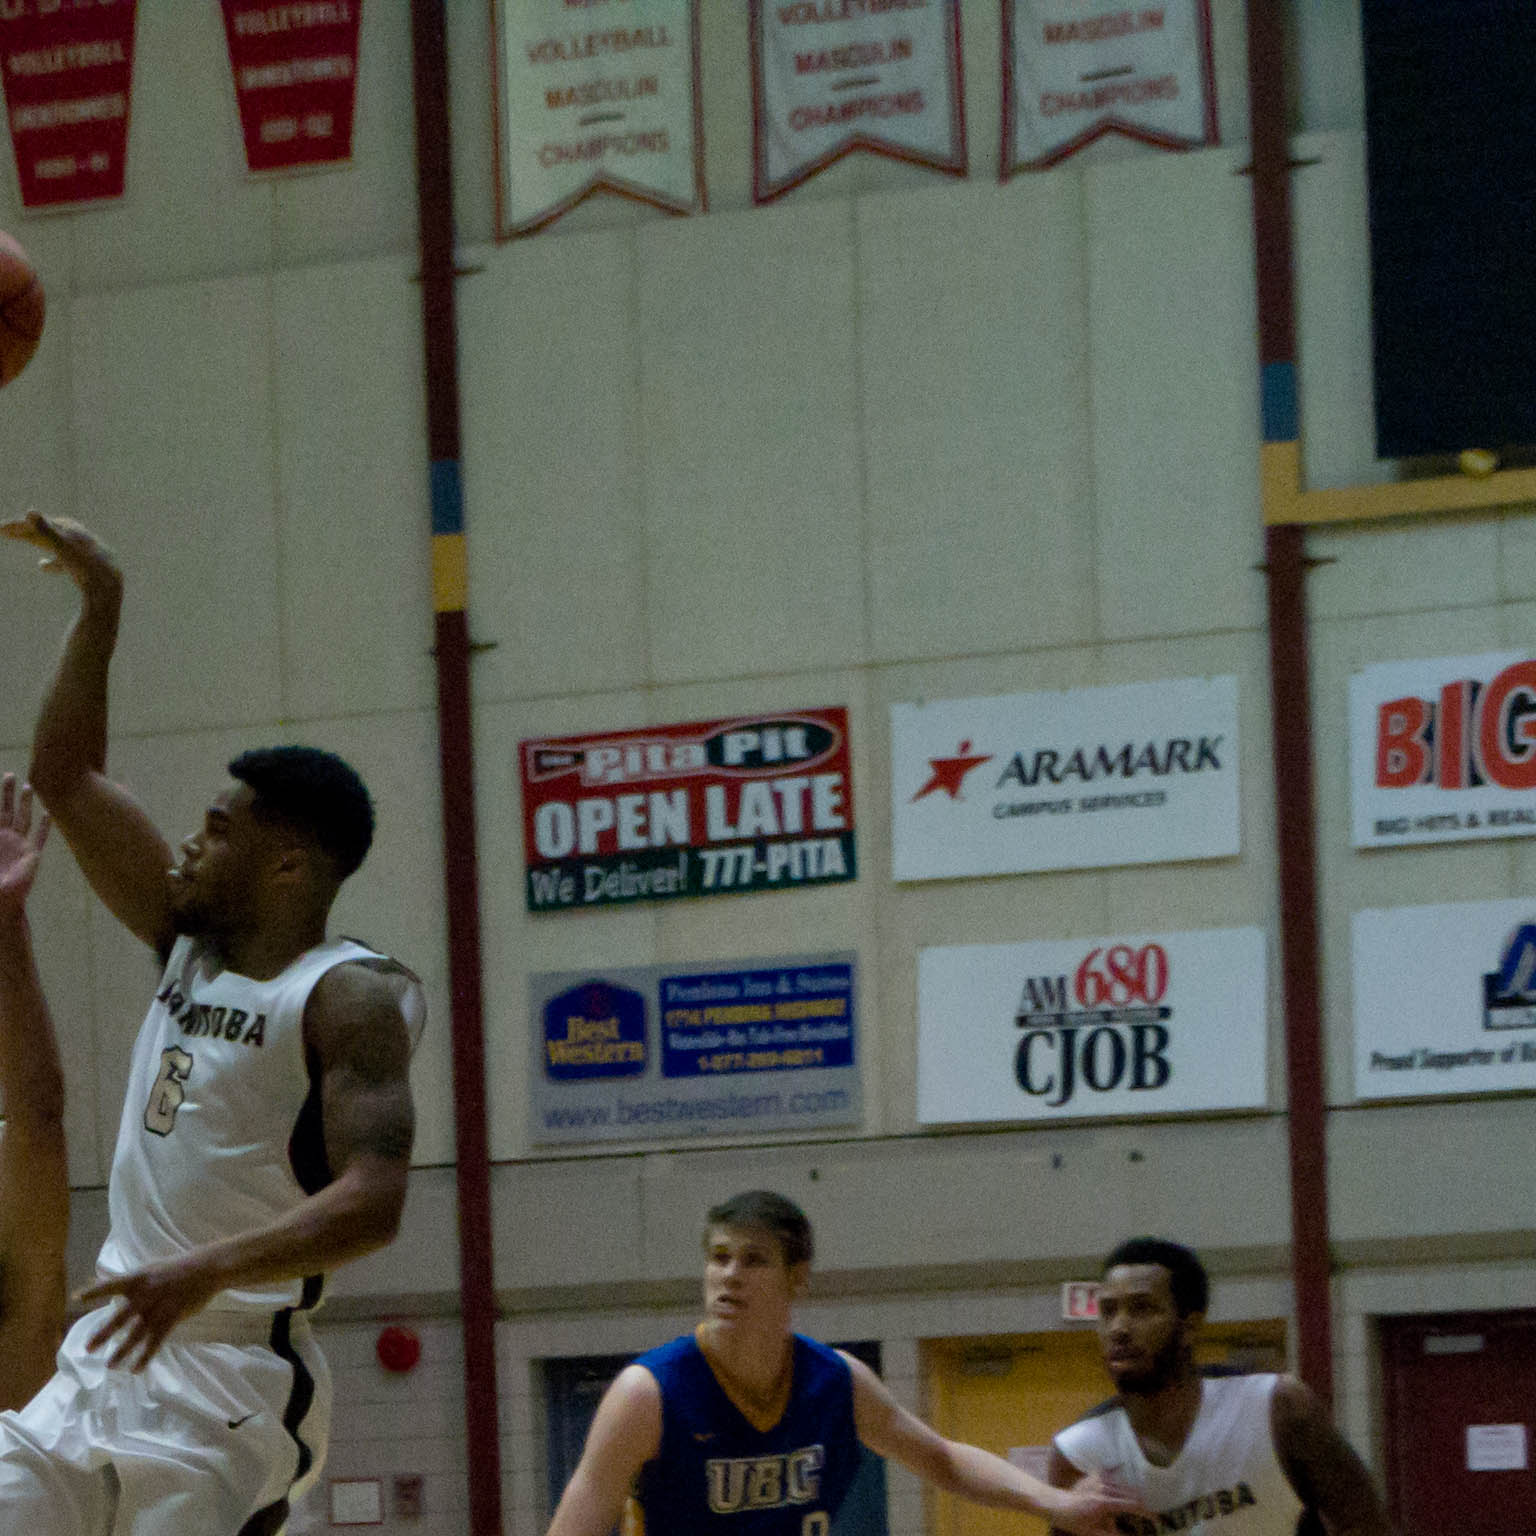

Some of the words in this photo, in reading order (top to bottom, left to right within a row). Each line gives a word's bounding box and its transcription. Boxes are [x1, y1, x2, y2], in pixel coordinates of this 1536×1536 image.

[582, 743, 707, 784] Pita
[722, 725, 811, 767] Pit
[995, 734, 1225, 789] ARAMARK
[534, 787, 691, 860] OPEN
[703, 770, 846, 842] LATE
[530, 864, 576, 905] We
[698, 835, 847, 889] 777-PITA
[1016, 974, 1071, 1017] AM
[1074, 942, 1170, 1009] 680
[547, 1038, 644, 1067] Western
[567, 1014, 621, 1043] Best
[1014, 1023, 1172, 1108] CJOB
[704, 1443, 826, 1515] UBC
